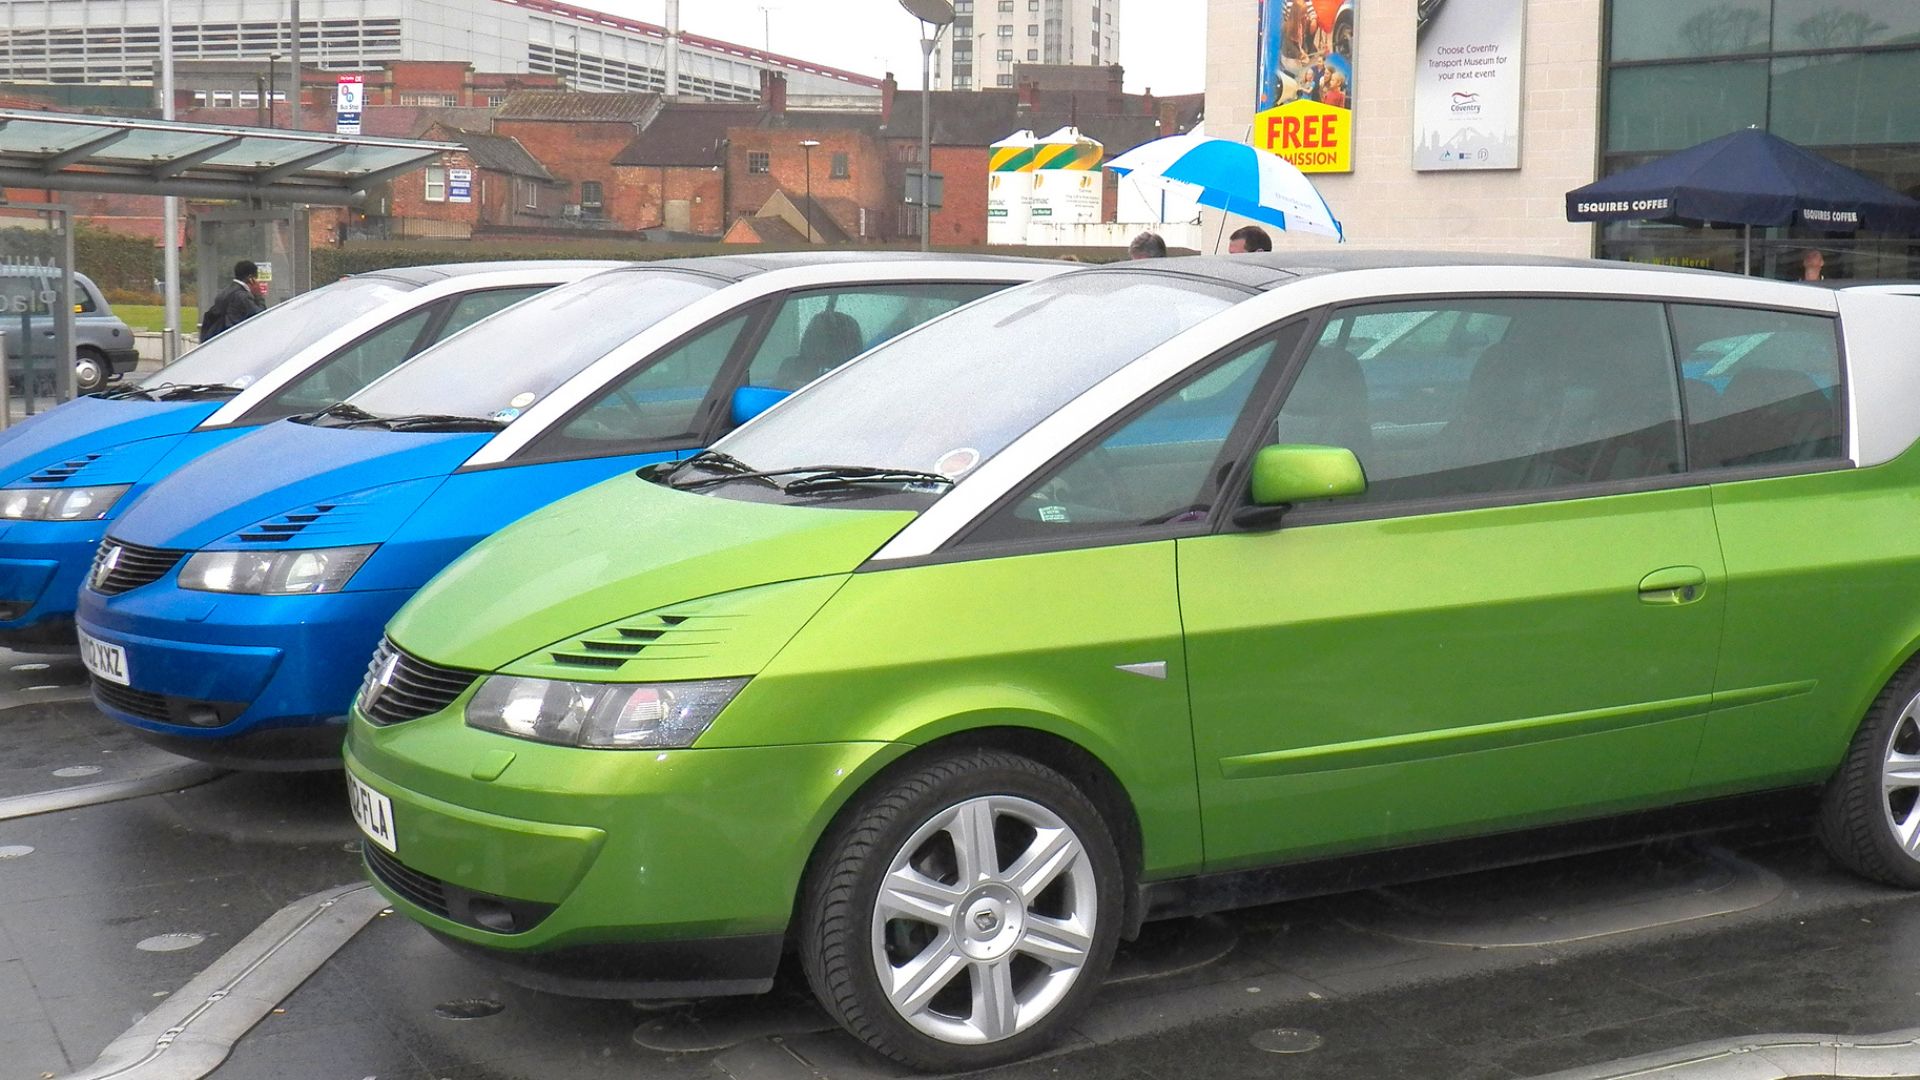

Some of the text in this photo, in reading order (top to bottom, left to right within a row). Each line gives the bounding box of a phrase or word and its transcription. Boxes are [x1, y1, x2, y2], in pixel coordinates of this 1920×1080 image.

[1437, 44, 1499, 55] Choose Coventry
[1429, 56, 1507, 69] Transport Museum for
[1439, 69, 1496, 82] your next event
[1450, 104, 1481, 113] Coventry
[1267, 114, 1338, 149] FREE
[1275, 152, 1337, 166] MISSION
[1578, 198, 1668, 213] ESQUIRES COFFEE
[1803, 209, 1857, 222] ESQUIRES COFFEE
[96, 643, 123, 677] XXZ
[360, 786, 389, 840] FLA
